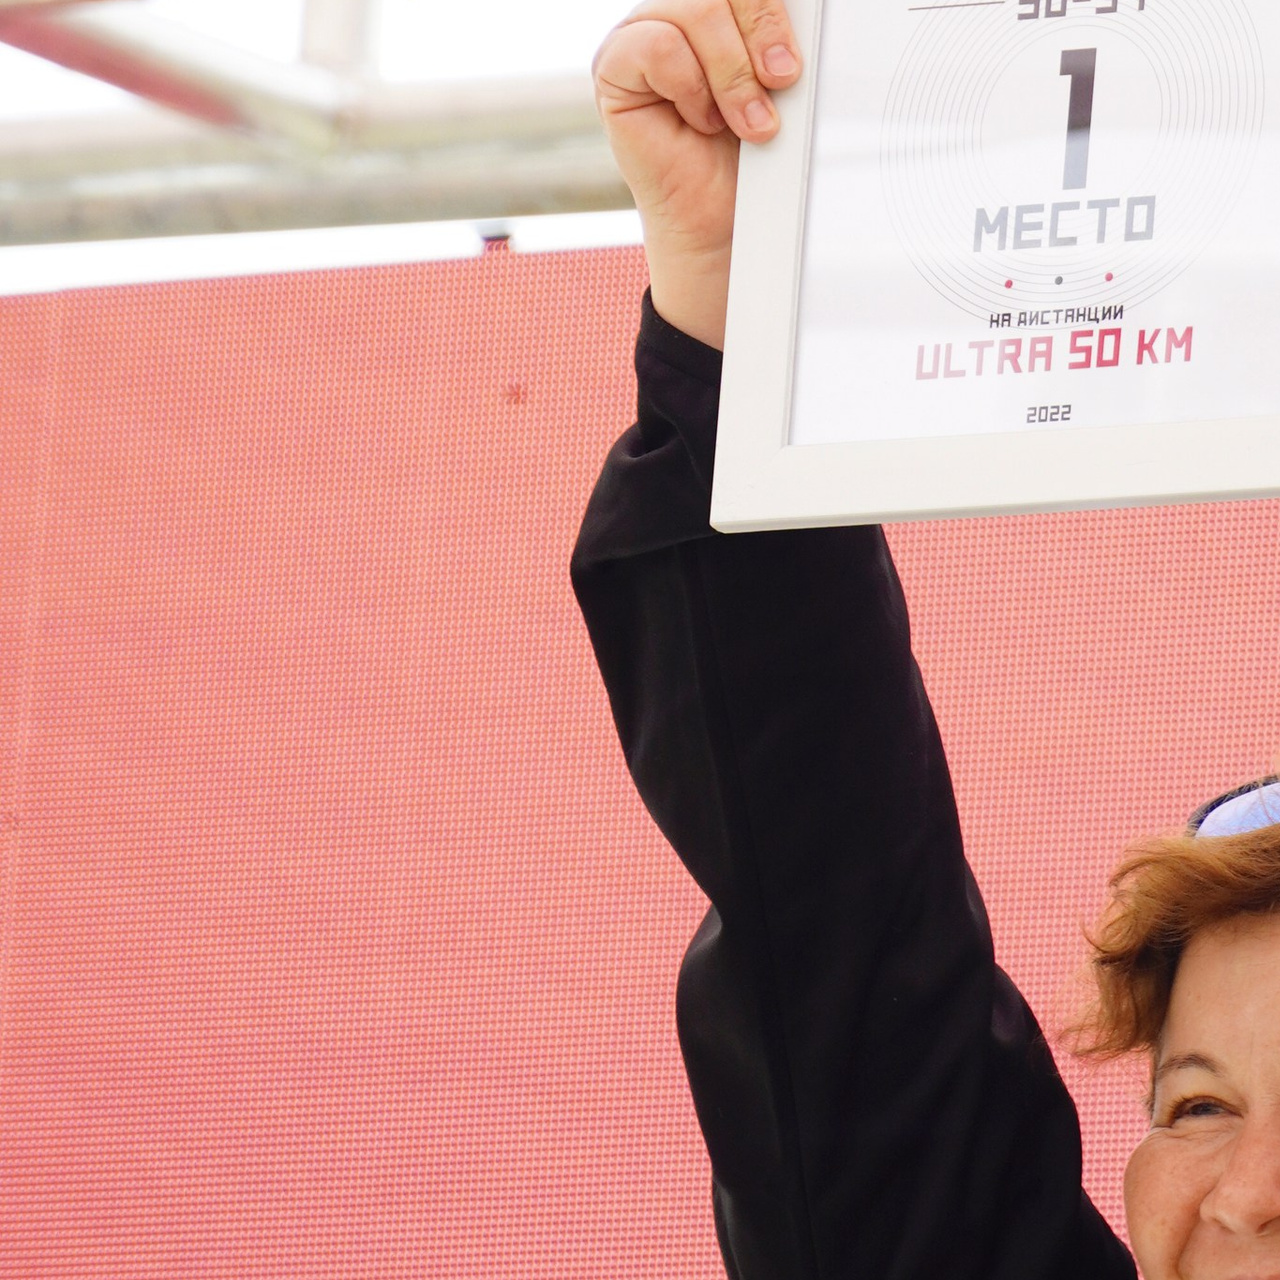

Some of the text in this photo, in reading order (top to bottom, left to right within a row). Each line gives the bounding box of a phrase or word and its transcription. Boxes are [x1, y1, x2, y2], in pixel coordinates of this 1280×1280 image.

[1059, 47, 1097, 190] 1
[972, 195, 1156, 252] МЕСТО
[988, 305, 1124, 329] НА ДИСТАНЦИИ
[915, 335, 1053, 380] ULTRA
[1067, 328, 1121, 370] 50
[1026, 404, 1072, 424] 2022
